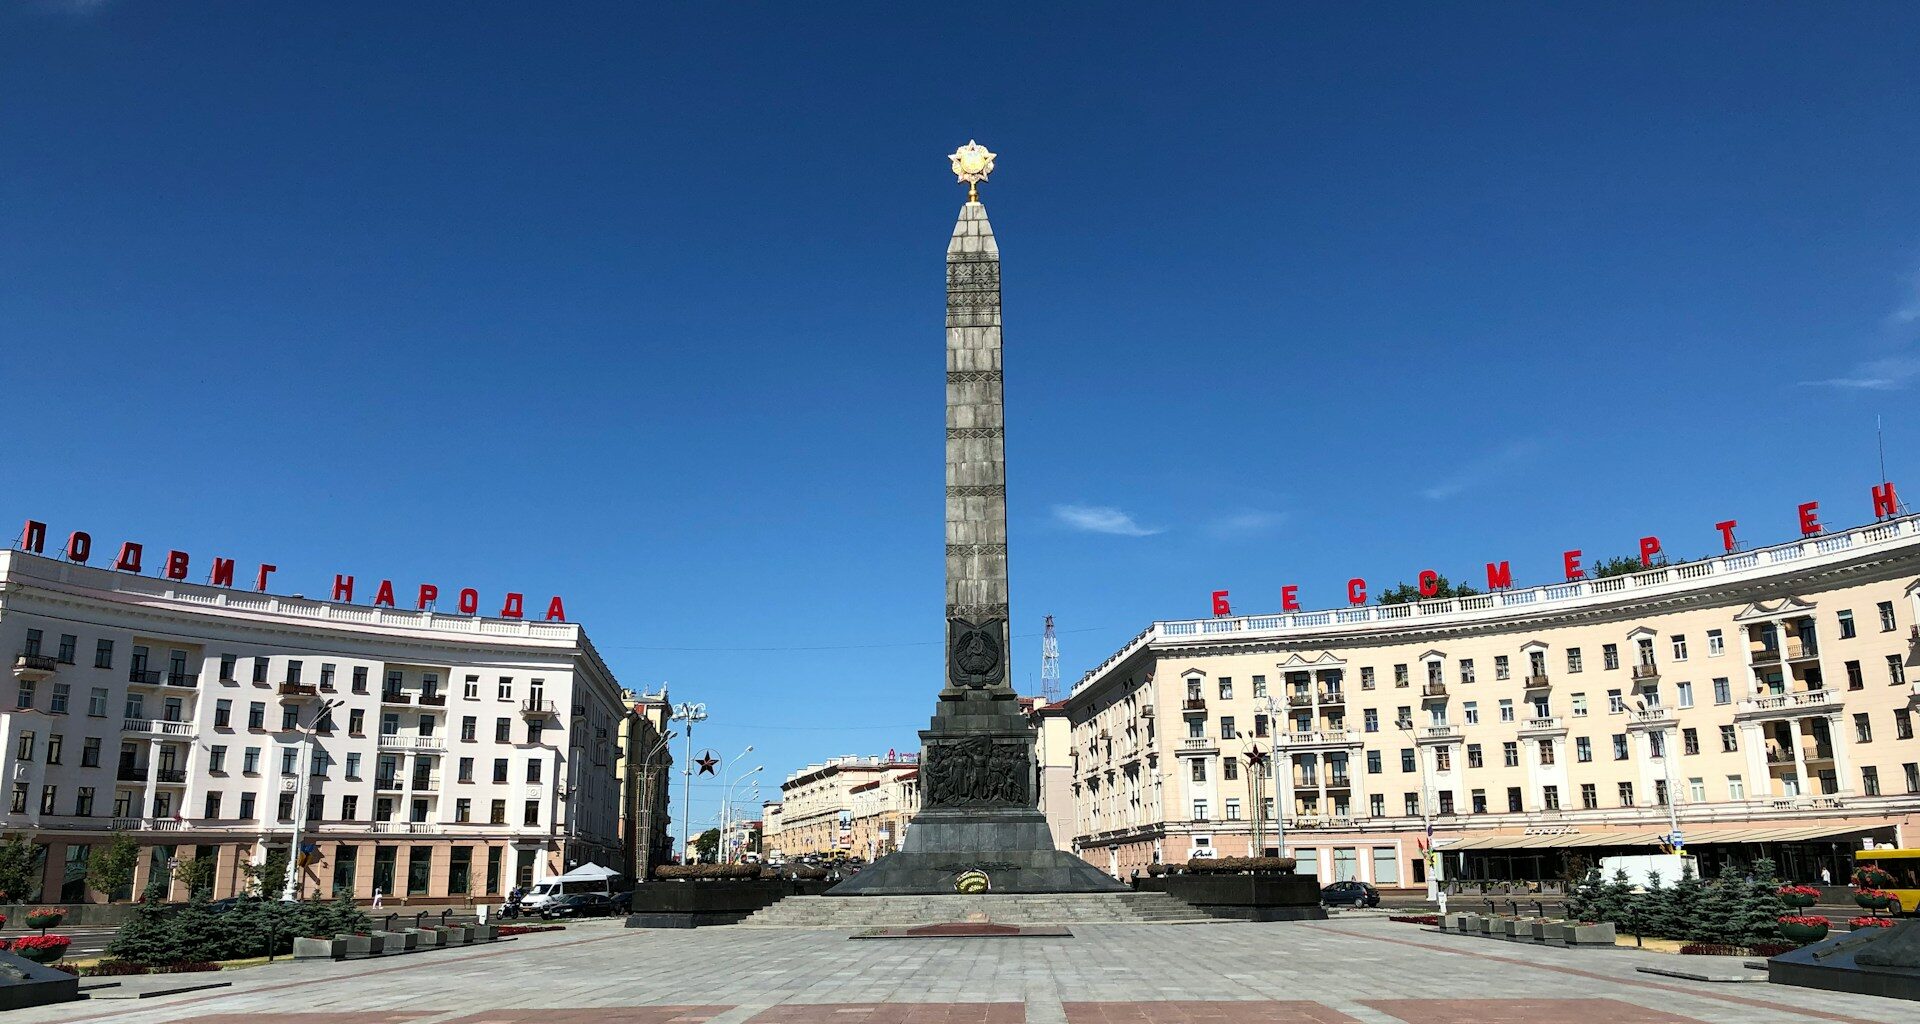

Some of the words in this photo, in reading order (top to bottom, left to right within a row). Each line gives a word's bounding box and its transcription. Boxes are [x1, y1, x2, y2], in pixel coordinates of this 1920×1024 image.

[23, 520, 277, 591] ПОДВИГ
[333, 574, 566, 622] НАРОДА
[1212, 482, 1898, 616] БЕССМЕРТЕН
